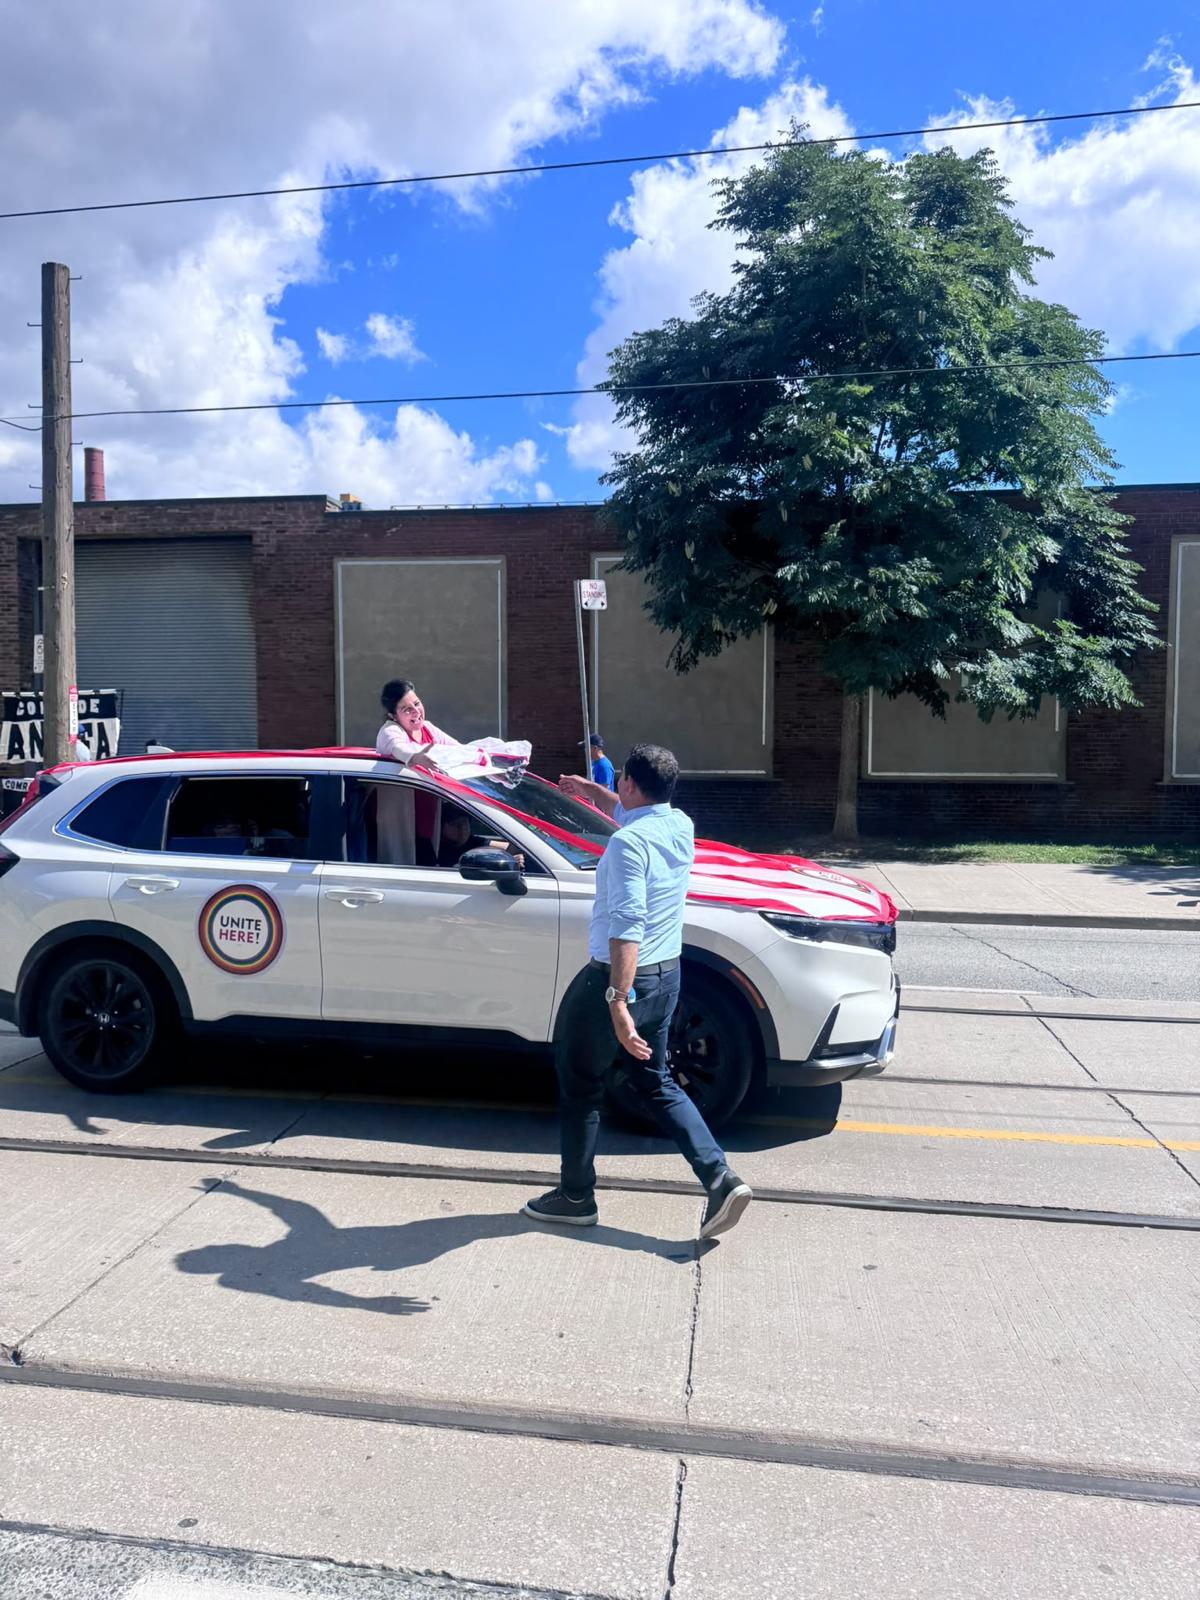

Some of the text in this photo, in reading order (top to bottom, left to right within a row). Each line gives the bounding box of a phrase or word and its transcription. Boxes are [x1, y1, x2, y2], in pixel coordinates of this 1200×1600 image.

[589, 582, 598, 590] NO
[220, 915, 262, 931] UNITE
[219, 928, 260, 944] HERE!
